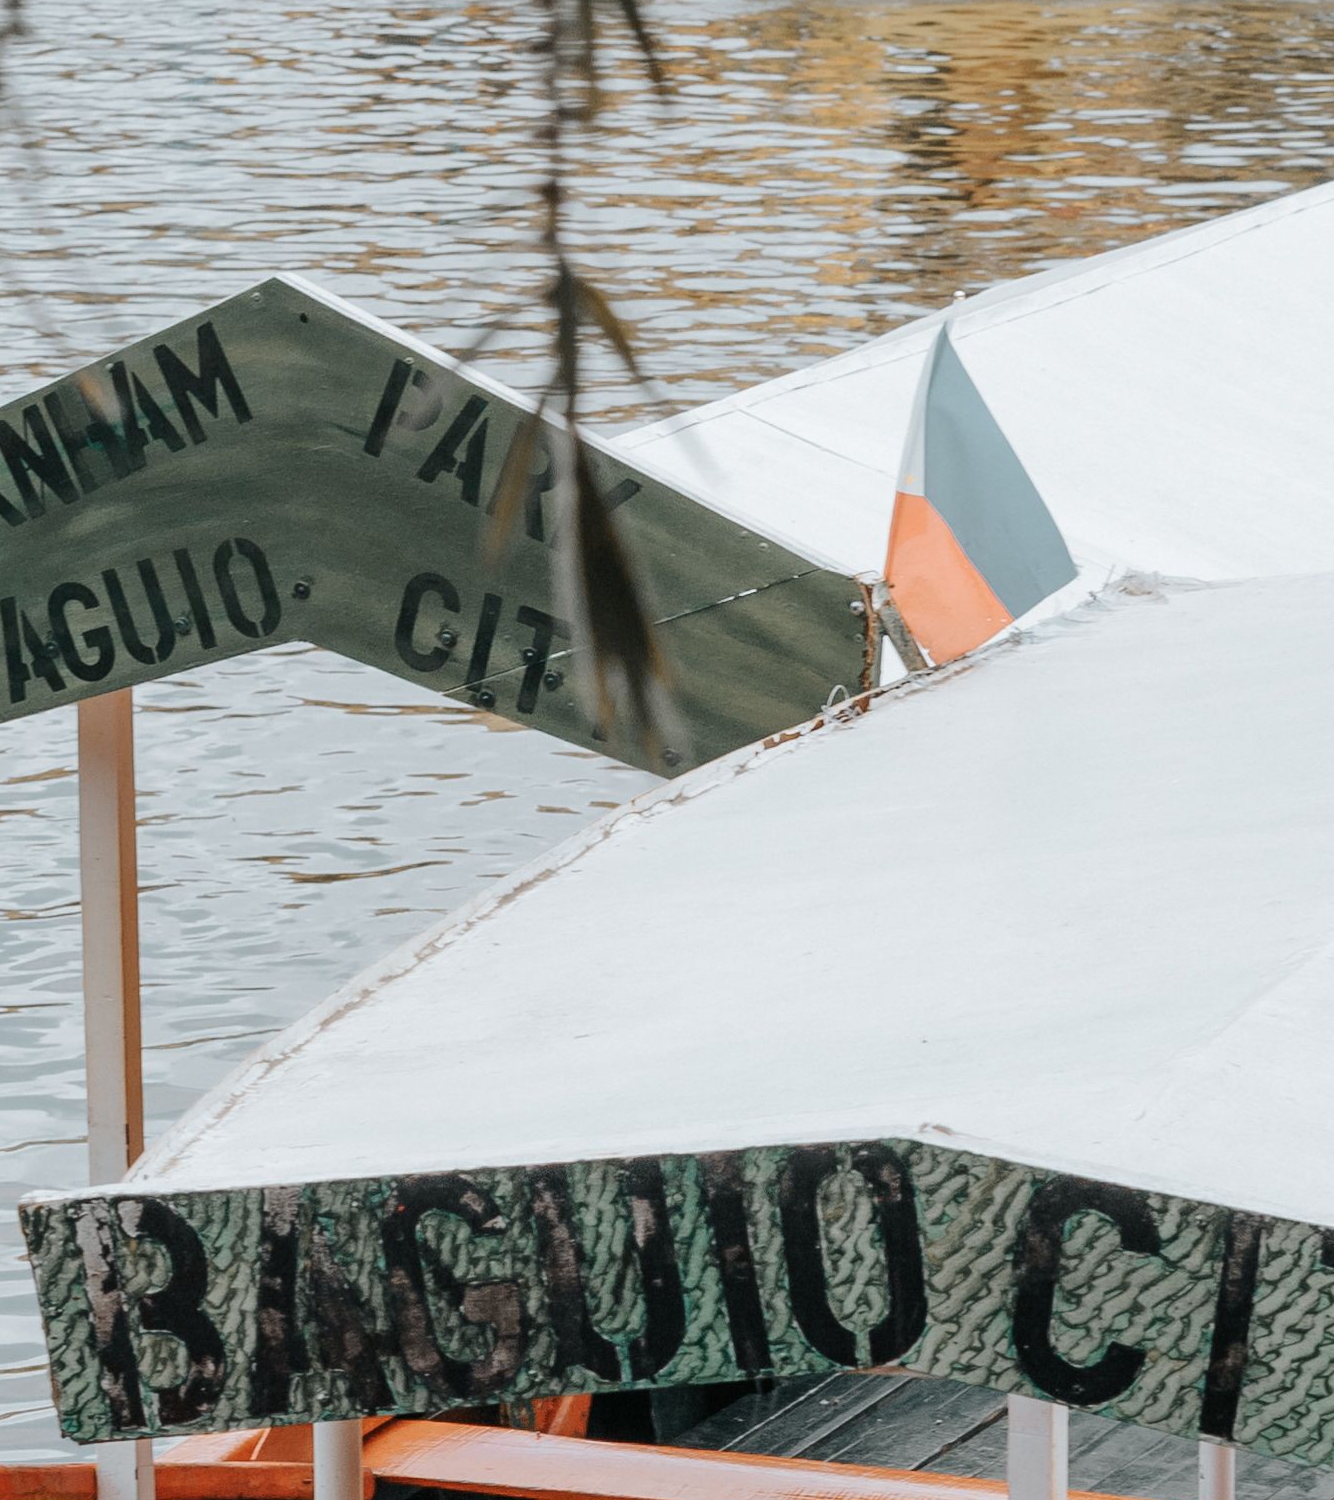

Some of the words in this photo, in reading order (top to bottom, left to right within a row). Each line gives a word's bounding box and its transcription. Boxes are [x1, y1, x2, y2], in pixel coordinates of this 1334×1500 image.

[364, 357, 643, 550] PAR
[394, 571, 609, 742] CIT
[74, 1138, 927, 1430] BAGUIO
